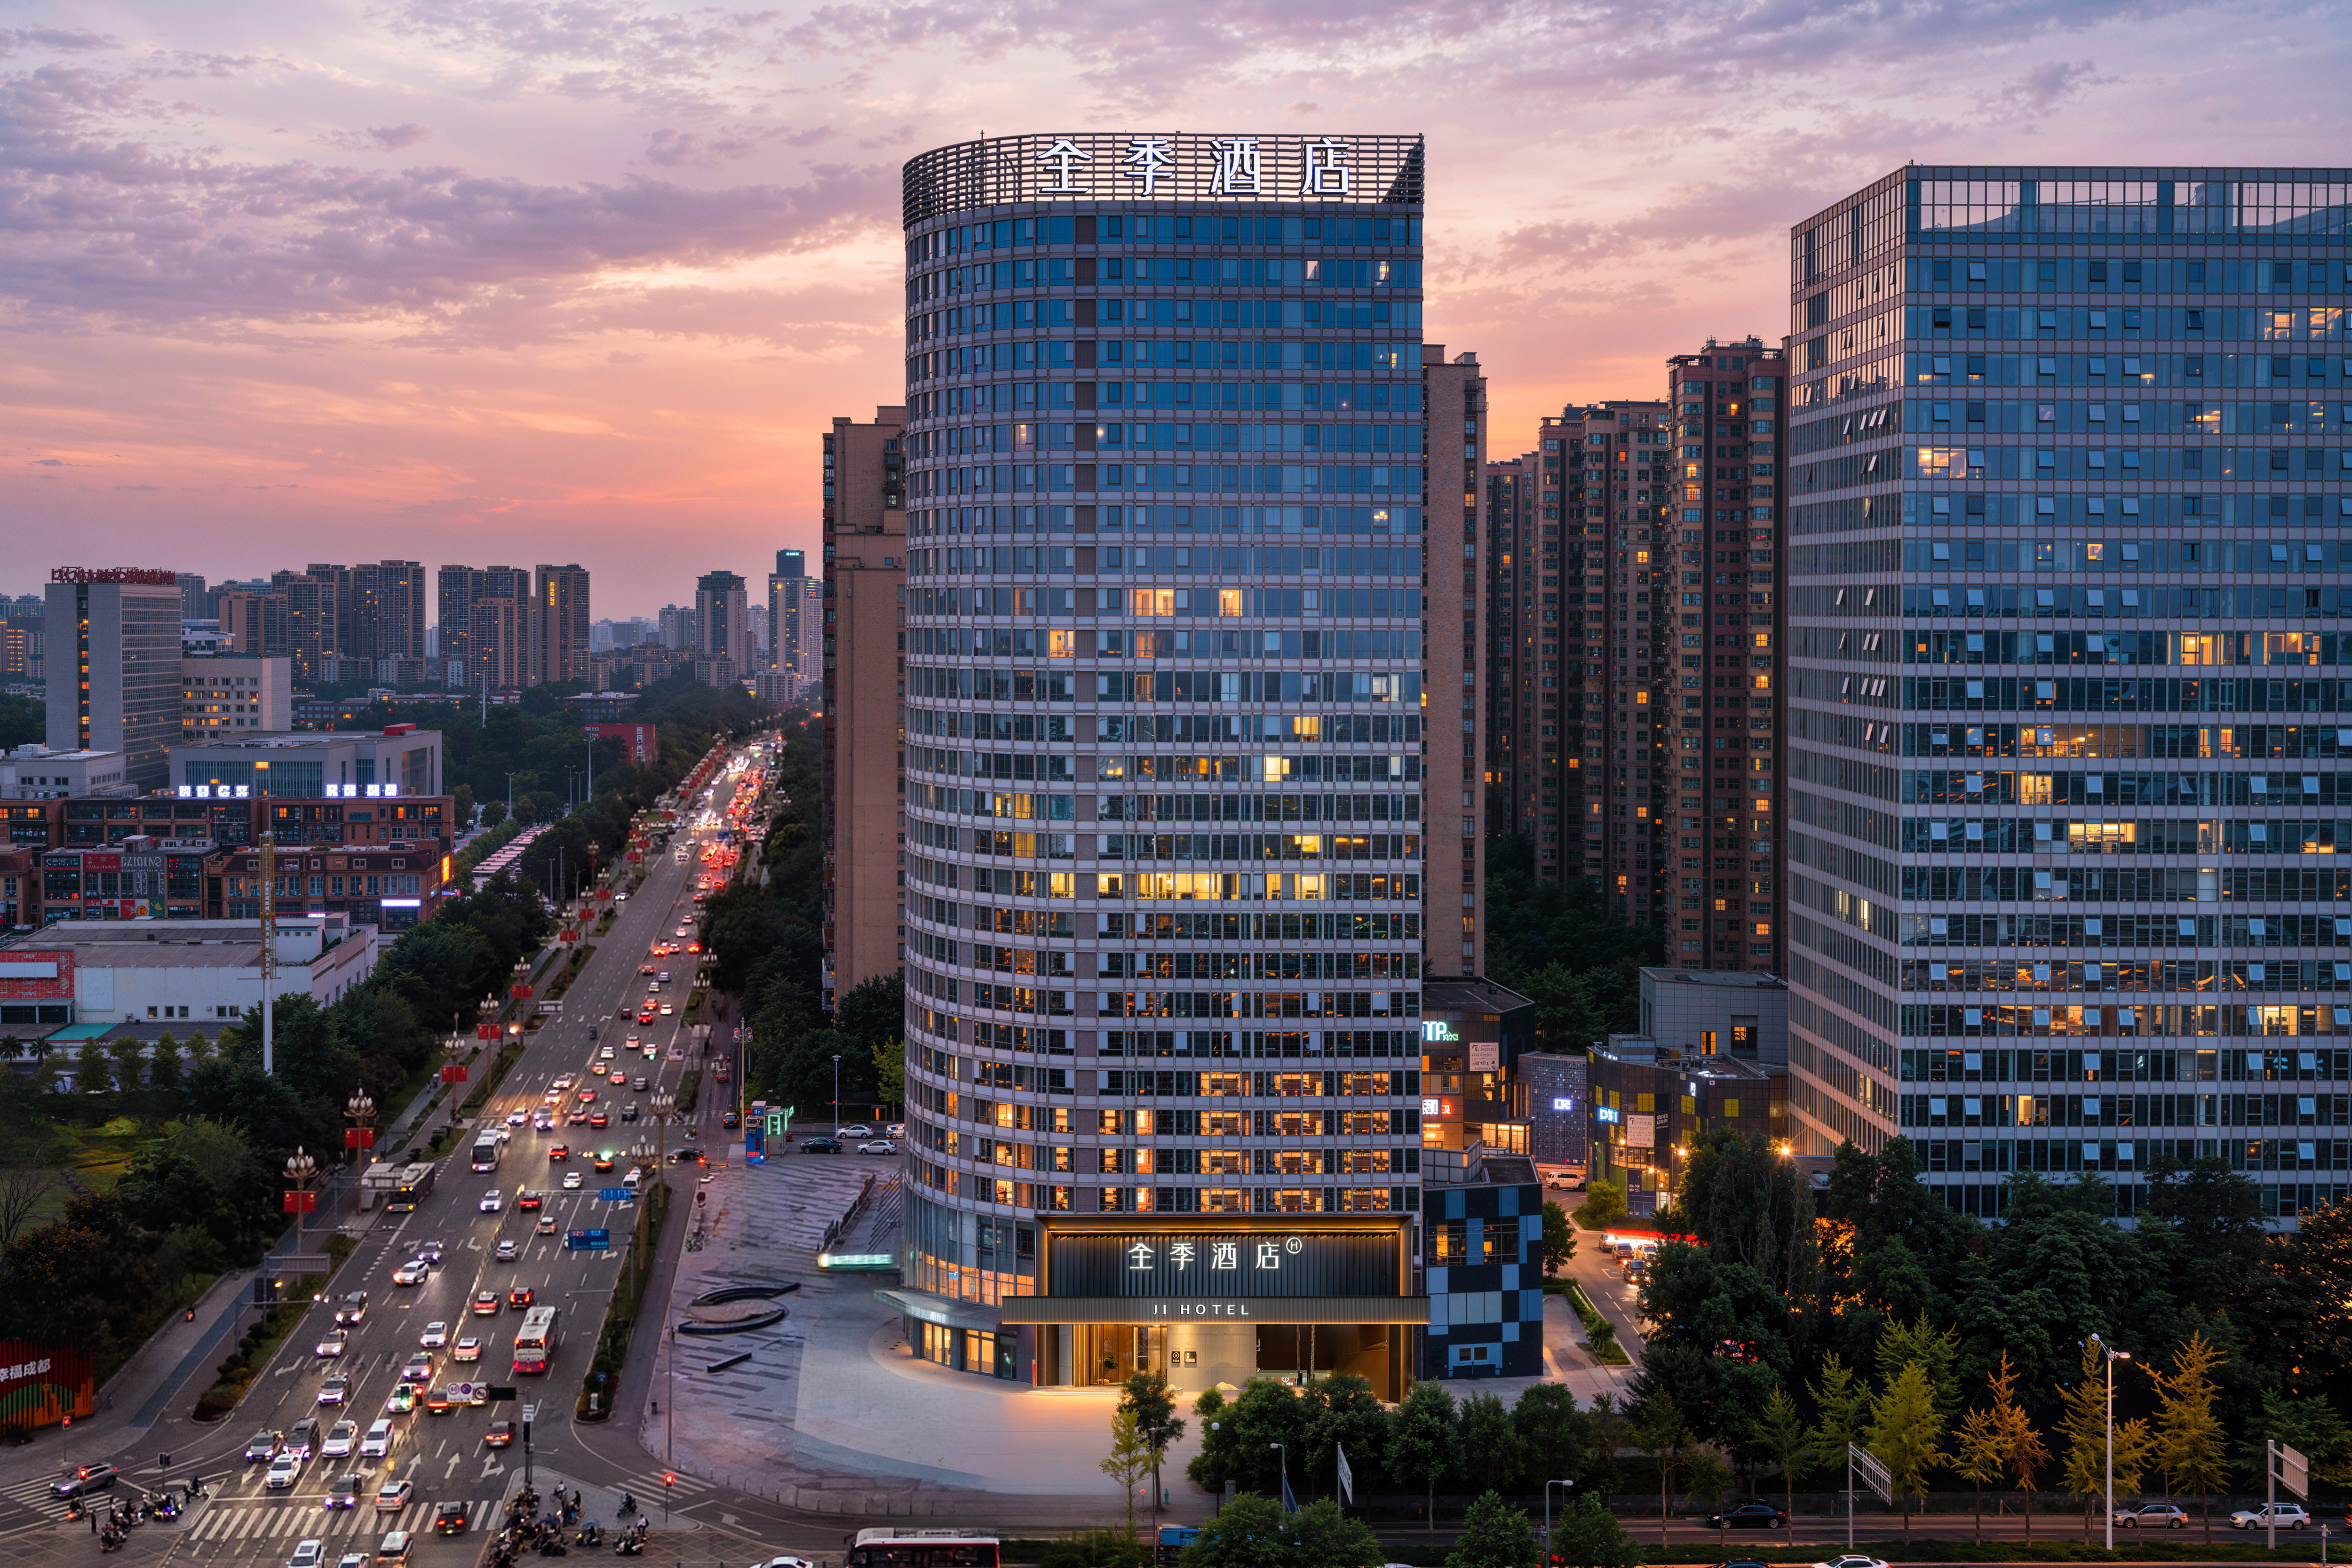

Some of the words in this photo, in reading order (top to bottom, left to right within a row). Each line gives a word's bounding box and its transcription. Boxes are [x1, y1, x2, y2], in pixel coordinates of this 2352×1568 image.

[1037, 137, 1350, 196] 全季酒店
[1128, 1242, 1279, 1270] 全季酒店
[1153, 1305, 1166, 1315] JI
[1181, 1305, 1249, 1315] HOTEL
[0, 1358, 50, 1382] 幸福成都
